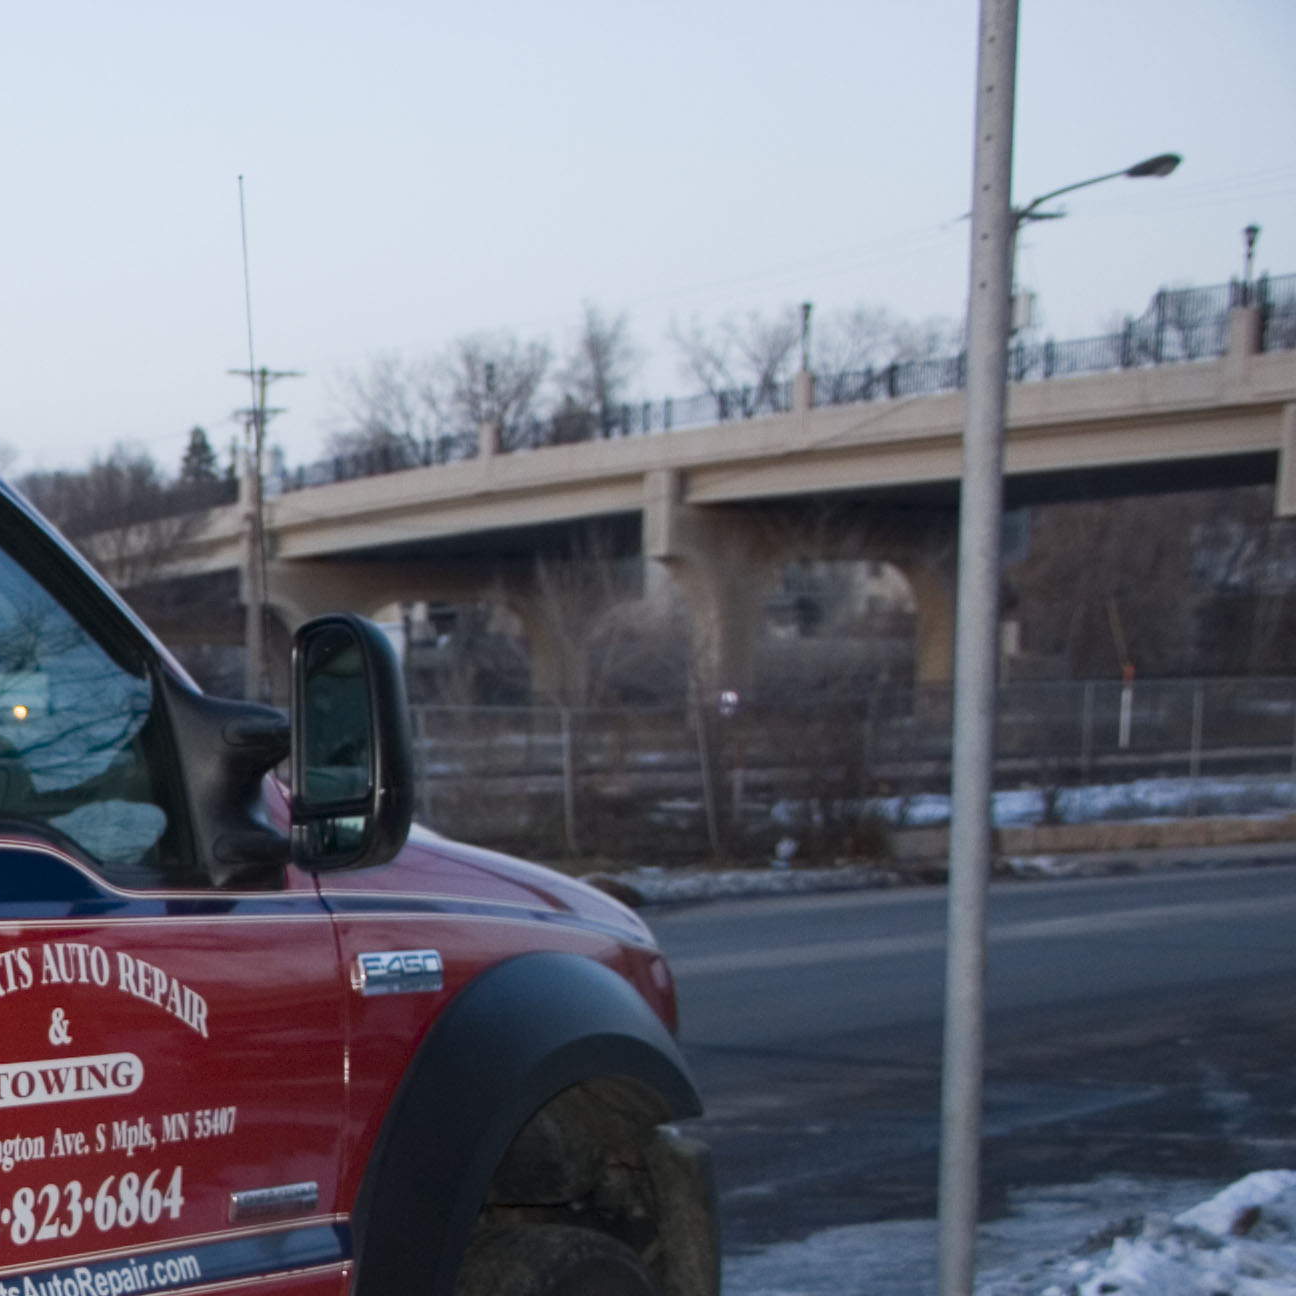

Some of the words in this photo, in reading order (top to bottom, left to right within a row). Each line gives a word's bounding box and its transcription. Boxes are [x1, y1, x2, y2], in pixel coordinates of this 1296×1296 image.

[41, 943, 110, 987] AUTO
[116, 951, 209, 1039] REPAIR
[48, 1007, 73, 1046] &
[49, 1127, 90, 1158] Ave.
[95, 1123, 107, 1153] S
[111, 1117, 157, 1158] Mpls,
[161, 1112, 190, 1143] MN
[194, 1106, 237, 1139] 55407
